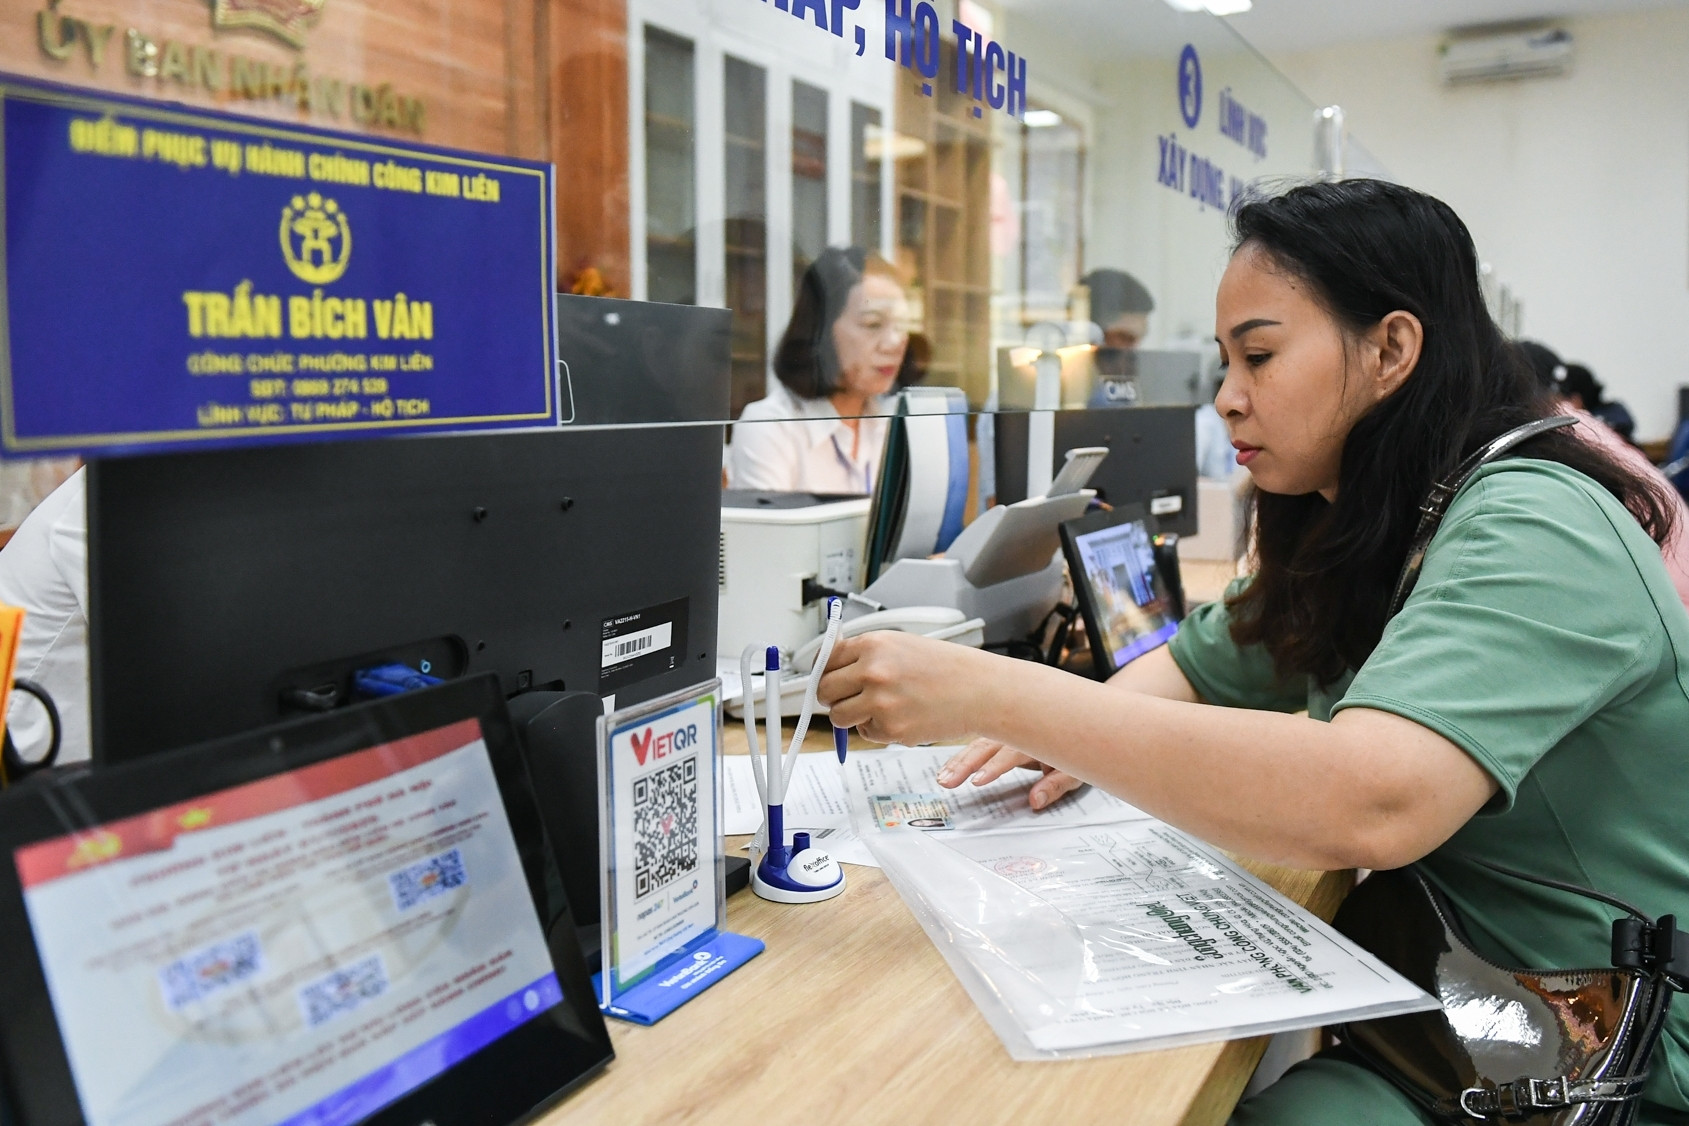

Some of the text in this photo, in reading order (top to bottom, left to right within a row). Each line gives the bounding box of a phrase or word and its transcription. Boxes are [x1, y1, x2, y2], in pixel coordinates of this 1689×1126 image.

[125, 27, 224, 90] BAN
[952, 18, 1027, 121] TỊCH
[142, 128, 207, 171] PHỤC
[211, 139, 242, 177] VỤ
[373, 159, 423, 193] CÔNG
[425, 169, 461, 198] KIM
[462, 172, 500, 203] LIÊN
[1158, 132, 1187, 193] XÂY
[288, 287, 368, 339] BÍCH
[372, 291, 434, 340] VÂN
[1223, 930, 1257, 952] CÔNG
